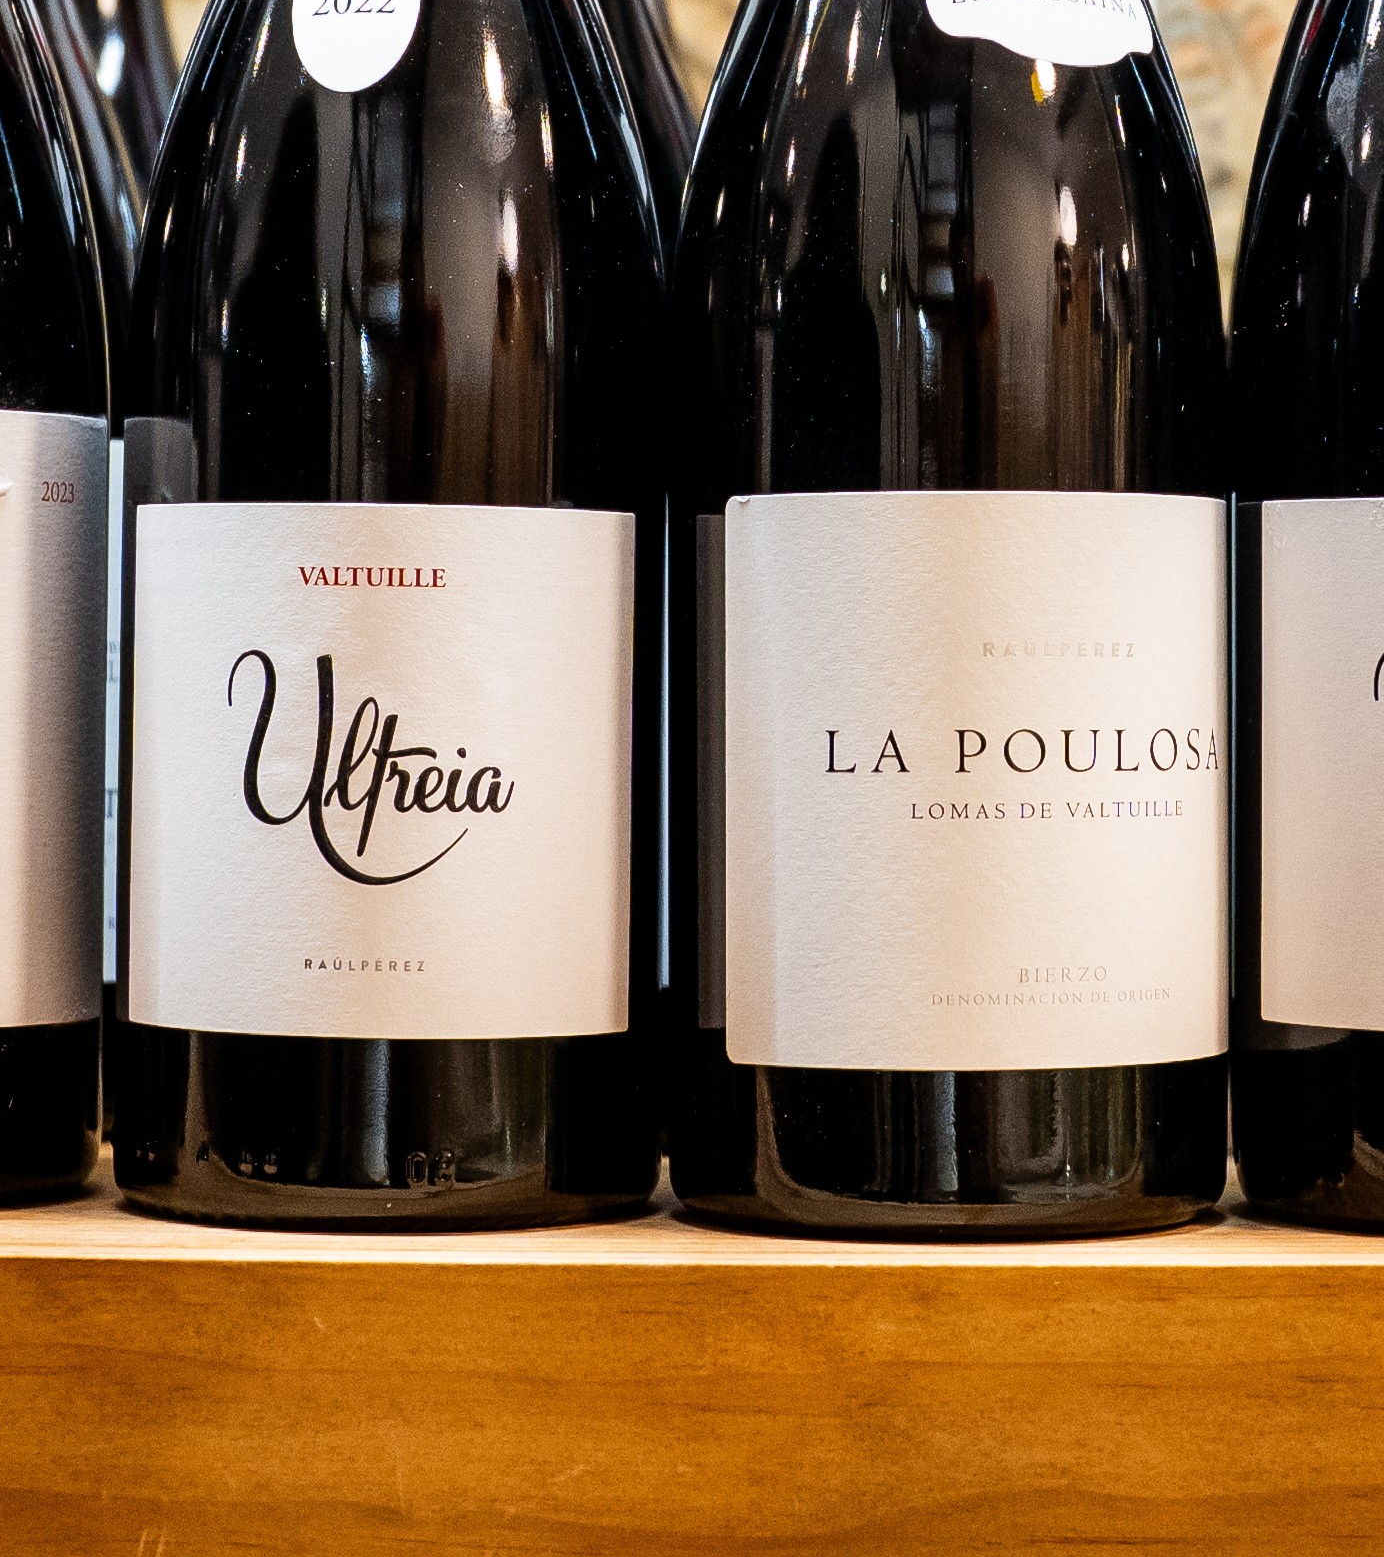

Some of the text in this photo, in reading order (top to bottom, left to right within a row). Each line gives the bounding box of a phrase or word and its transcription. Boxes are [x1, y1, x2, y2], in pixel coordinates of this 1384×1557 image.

[40, 480, 76, 504] 2023
[297, 565, 448, 589] VALTUILLE
[824, 727, 1220, 775] LA POULOSA
[227, 649, 514, 886] Ultreia
[910, 799, 1184, 821] LOMAS DE VALTUILLE
[1018, 965, 1108, 984] BIERZO
[931, 987, 1172, 1006] DENOMINACIÓN DE ORIGEN
